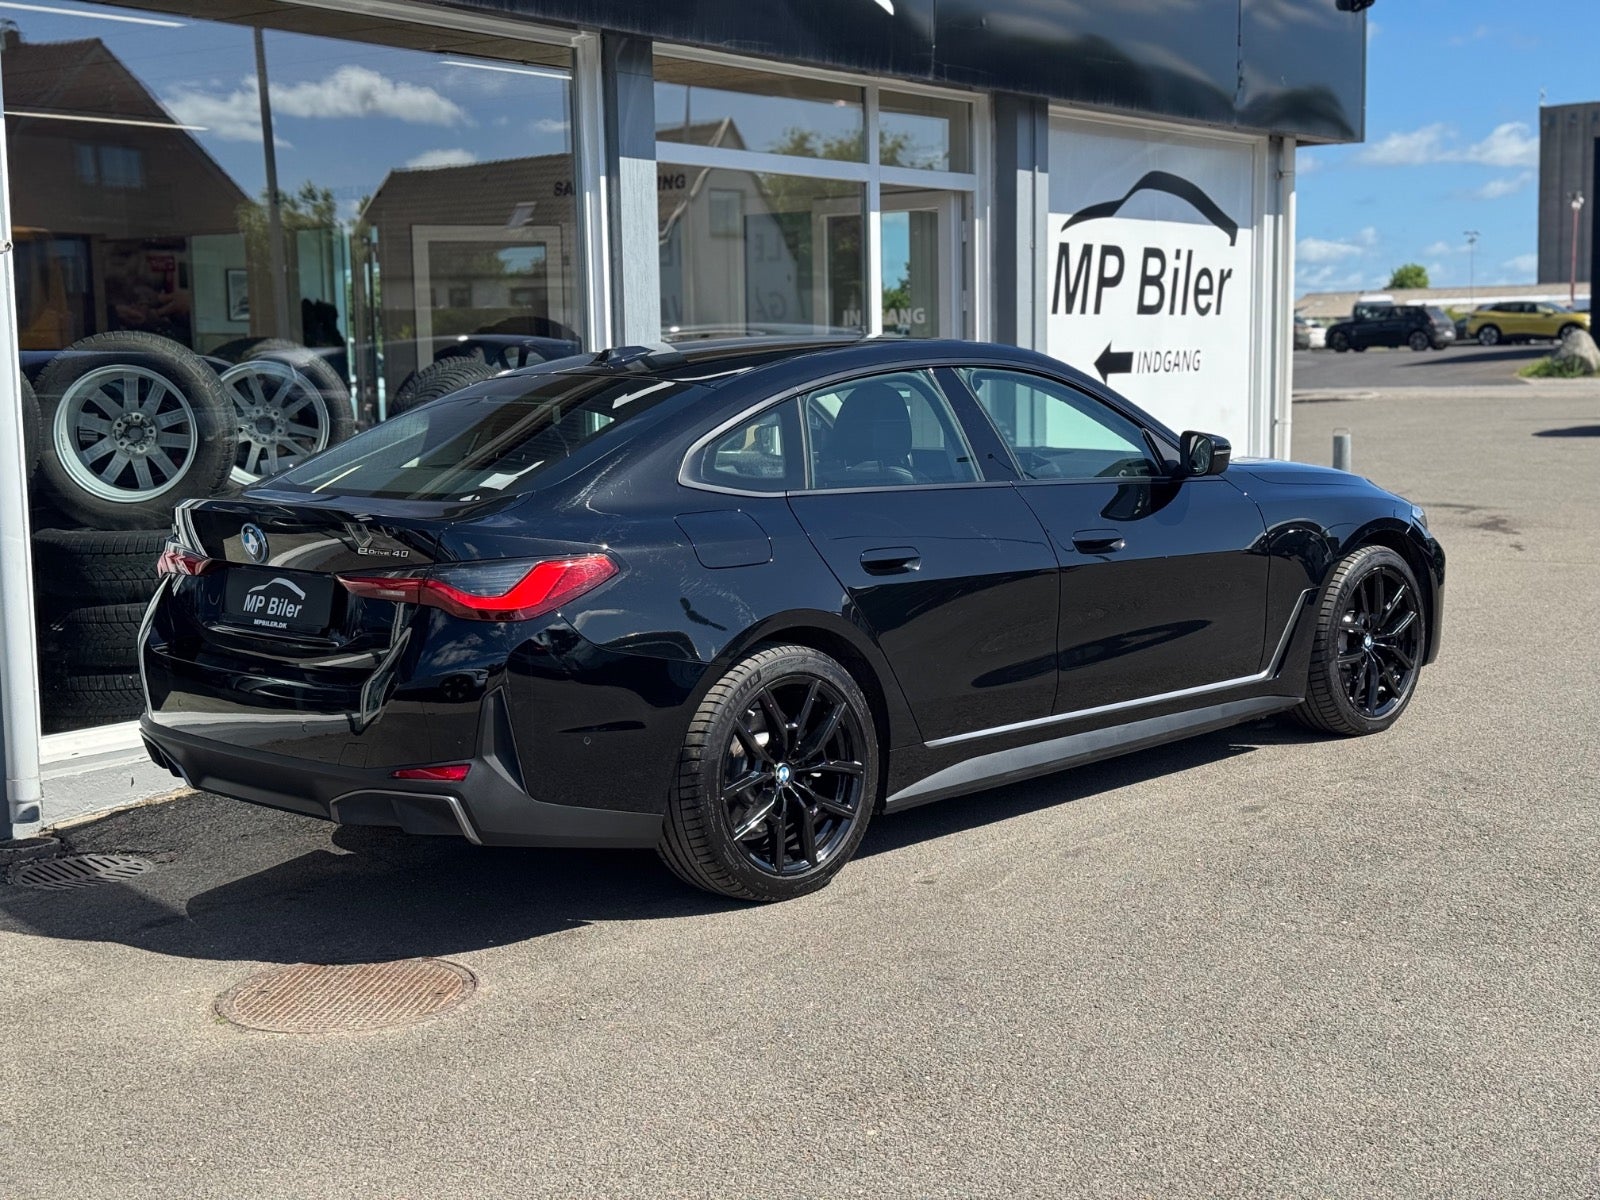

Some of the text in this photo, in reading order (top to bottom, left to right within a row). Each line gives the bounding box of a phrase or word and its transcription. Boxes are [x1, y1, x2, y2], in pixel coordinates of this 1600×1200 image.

[1051, 241, 1233, 317] MP Biler
[842, 308, 926, 326] INANG
[1136, 349, 1201, 374] INDGANG
[243, 594, 303, 618] MP Biler
[253, 618, 288, 629] MPBILER.DK
